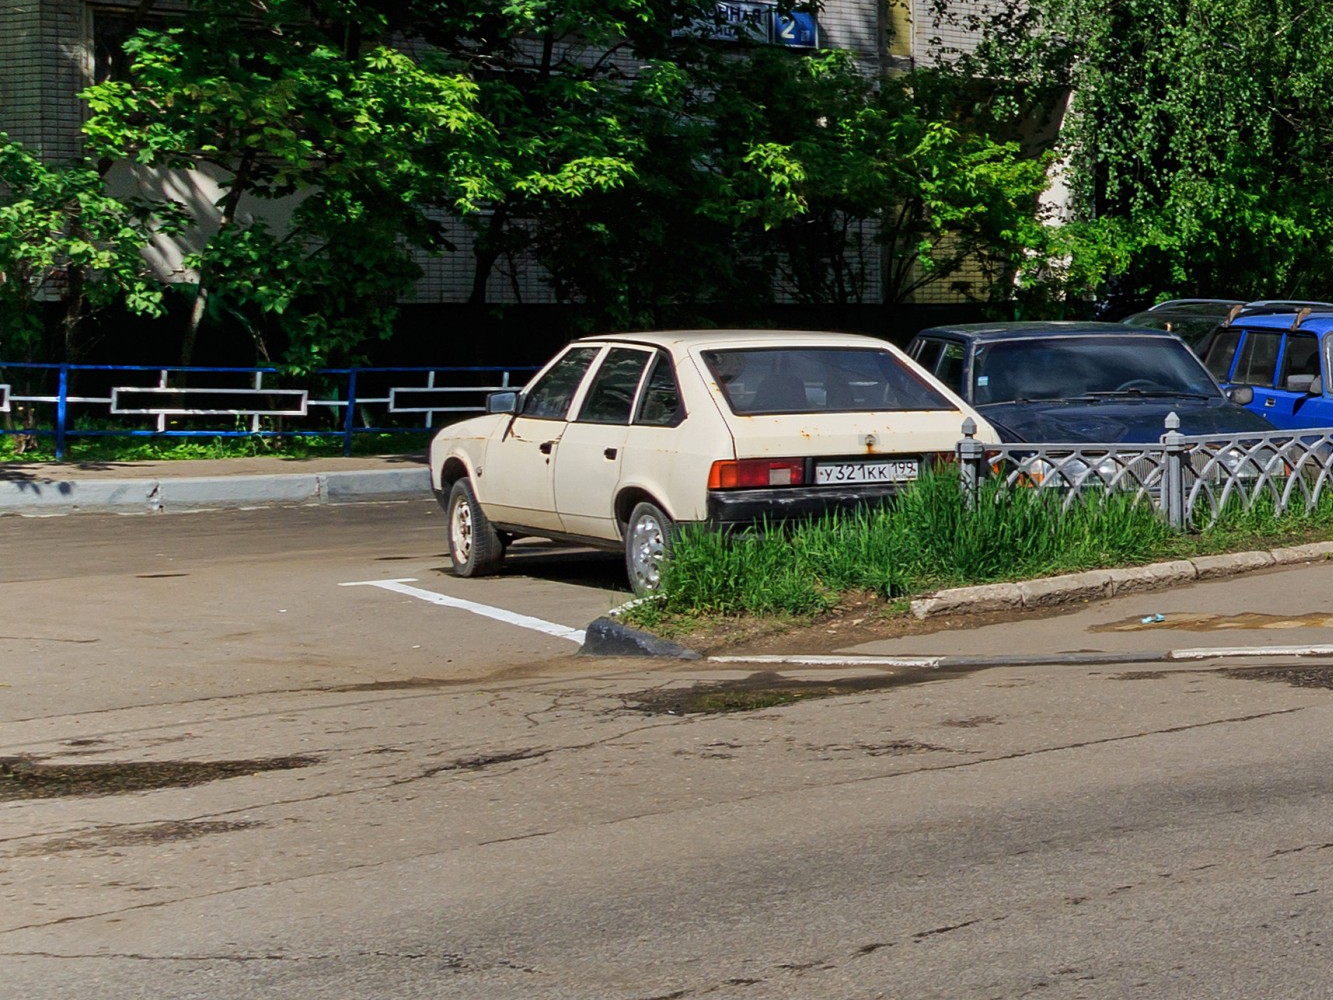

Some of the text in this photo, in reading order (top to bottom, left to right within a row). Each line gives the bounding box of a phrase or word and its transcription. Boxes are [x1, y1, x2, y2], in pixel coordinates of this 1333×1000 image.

[781, 14, 795, 39] 2
[825, 461, 916, 481] У321КК 199
